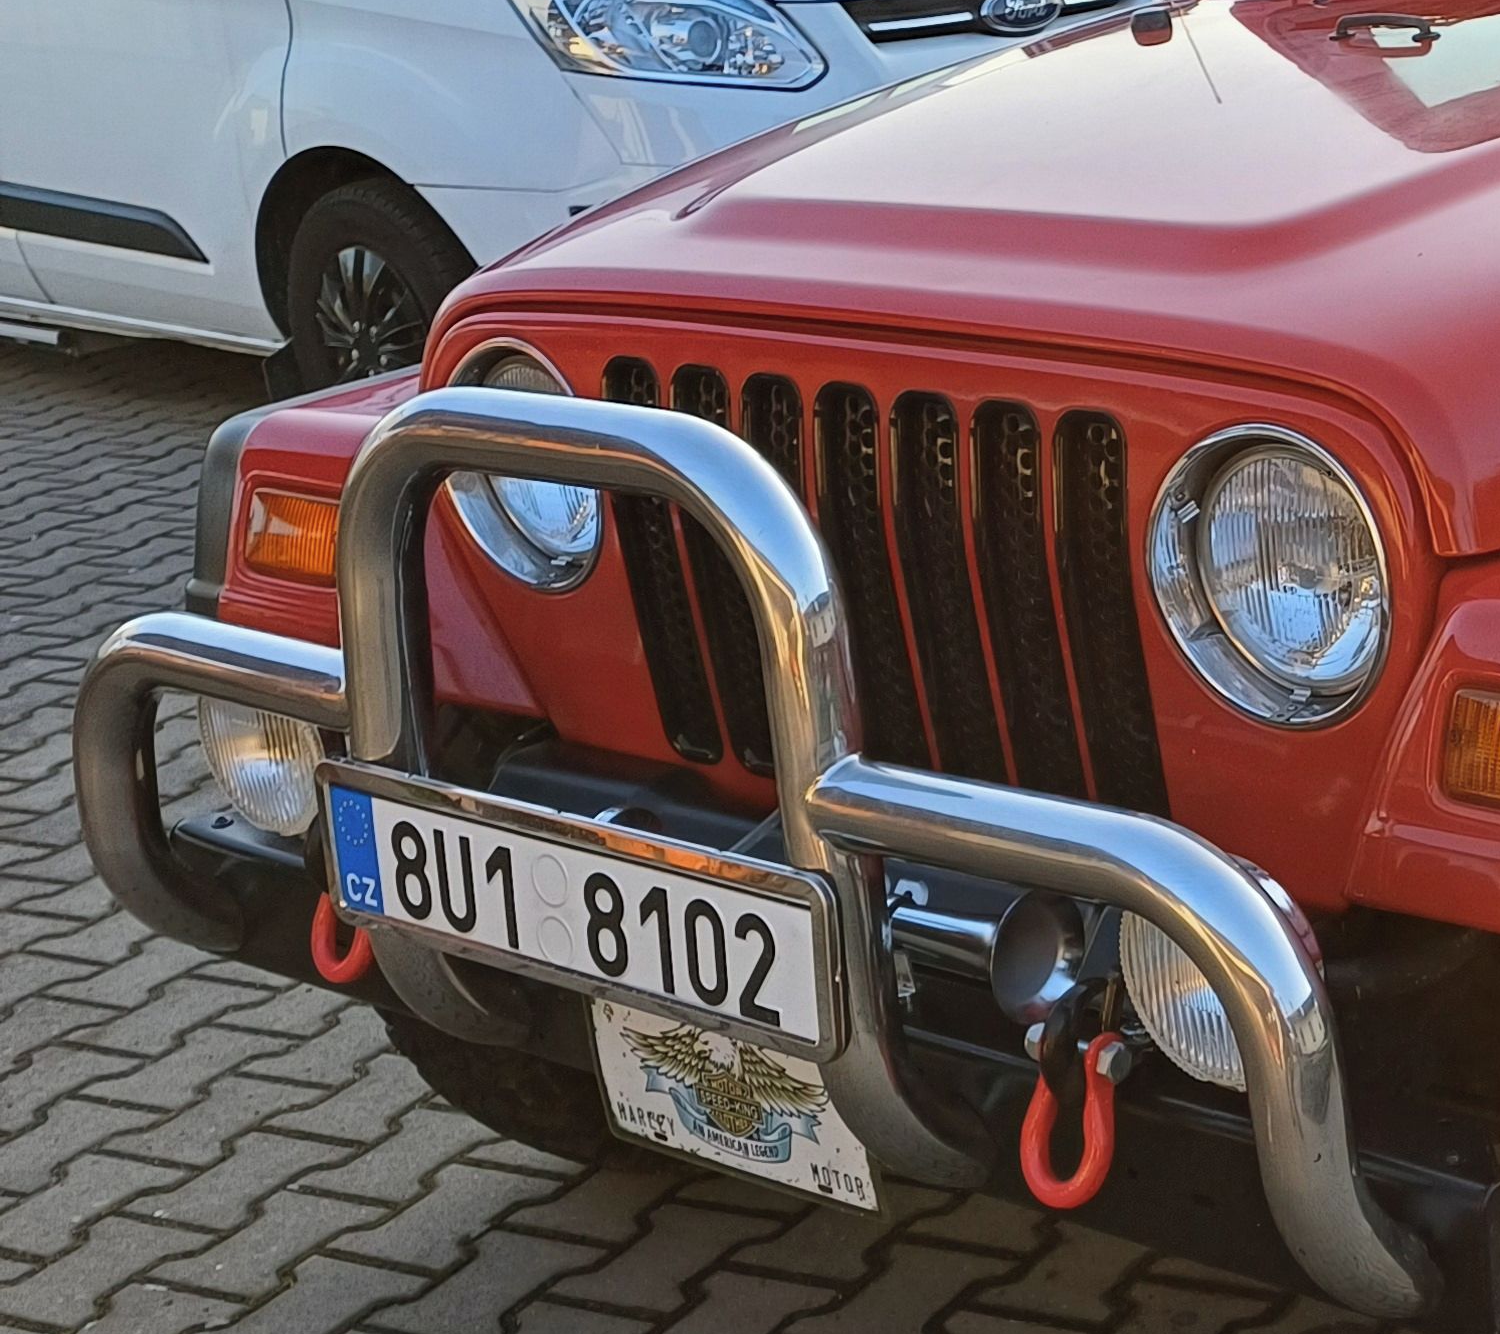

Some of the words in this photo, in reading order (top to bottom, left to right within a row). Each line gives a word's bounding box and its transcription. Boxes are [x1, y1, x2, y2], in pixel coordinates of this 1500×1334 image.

[346, 872, 378, 907] CZ
[390, 820, 520, 950] 8U1
[583, 872, 781, 1028] 8102
[706, 1128, 750, 1158] AMERICAN
[751, 1140, 780, 1159] LEGEND
[810, 1162, 866, 1201] MOTOR
